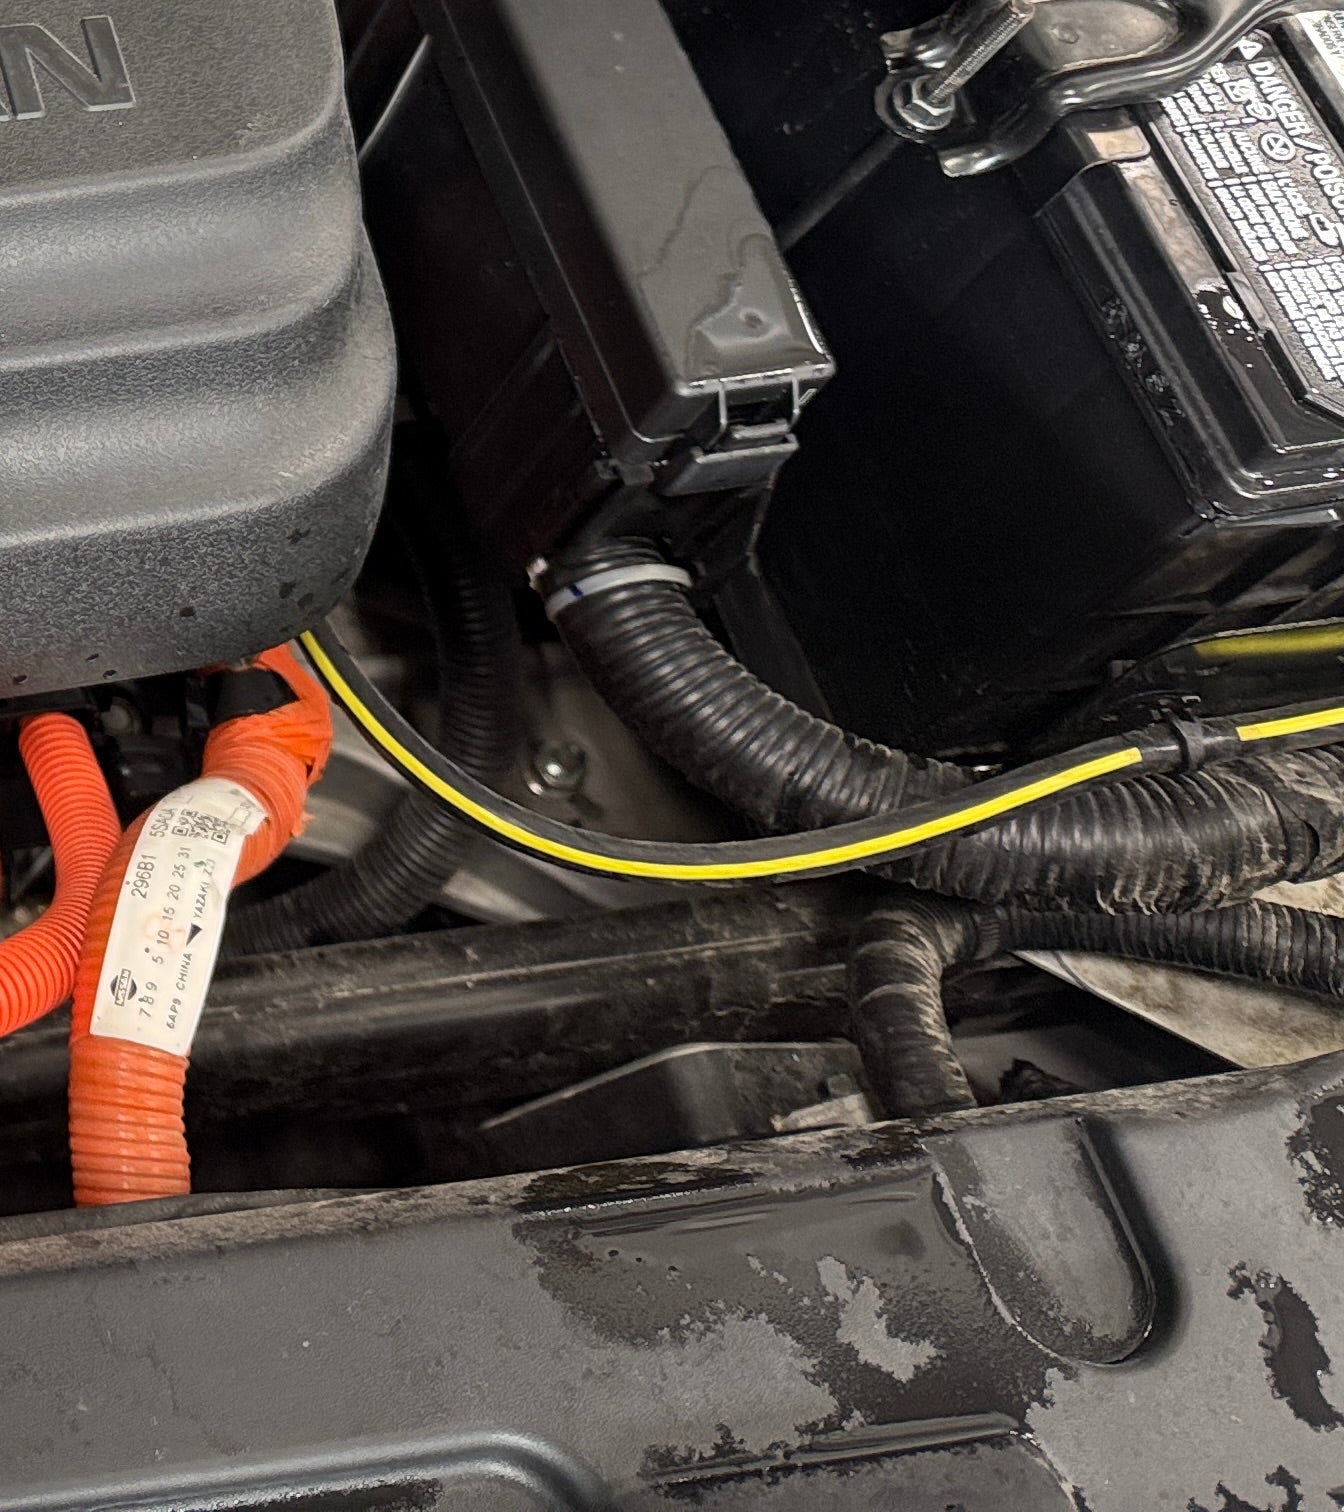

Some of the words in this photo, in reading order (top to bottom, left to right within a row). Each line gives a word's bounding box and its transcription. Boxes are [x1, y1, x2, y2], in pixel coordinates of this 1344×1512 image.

[1248, 61, 1311, 136] DANGER
[177, 847, 191, 859] 31
[131, 854, 156, 899] 296B1
[172, 864, 186, 879] 25
[167, 884, 181, 900] 20
[162, 907, 175, 920] 15
[156, 930, 169, 945] 10
[176, 953, 192, 991] CHINA
[193, 880, 211, 921] YAZAKI
[152, 956, 163, 964] 5
[145, 982, 157, 991] 9
[139, 1008, 151, 1017] 7
